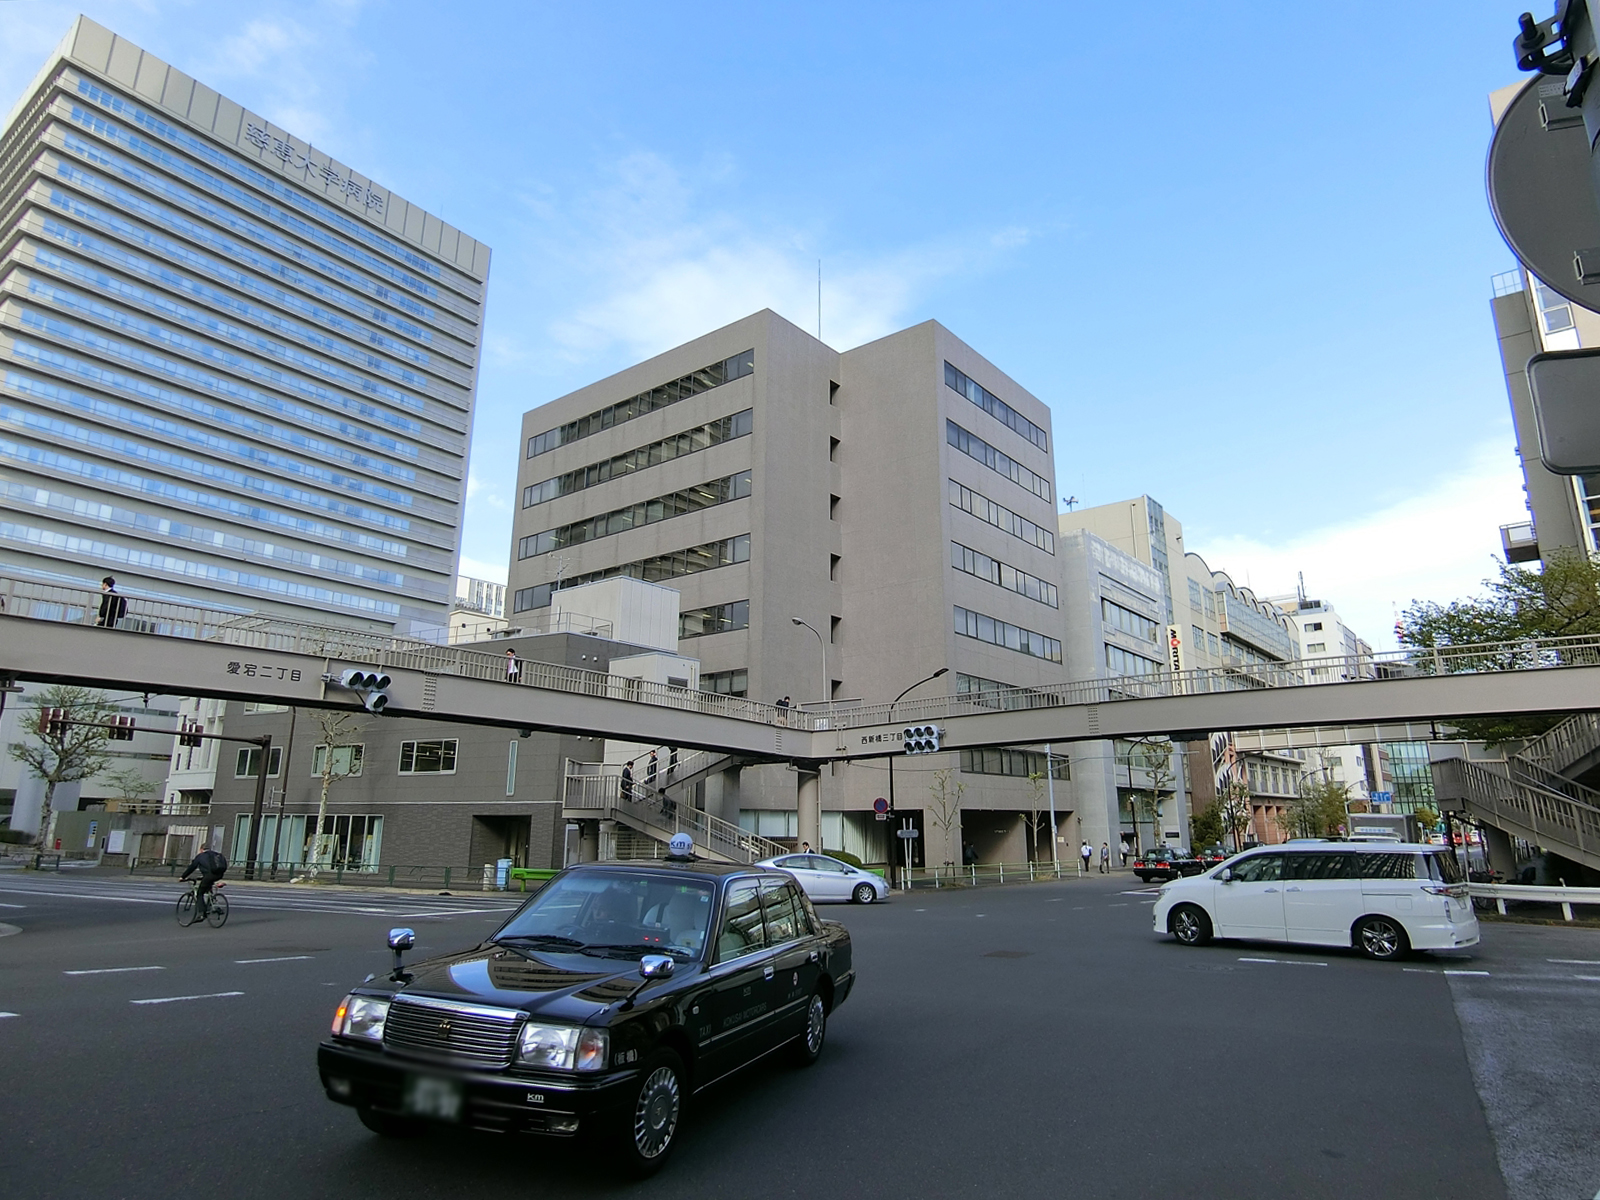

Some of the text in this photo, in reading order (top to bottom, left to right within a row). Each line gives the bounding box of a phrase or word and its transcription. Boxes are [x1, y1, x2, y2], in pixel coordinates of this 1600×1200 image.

[244, 122, 384, 215] 慈恵大学病院
[1170, 628, 1181, 671] MORITA
[227, 661, 302, 682] 愛宕二丁目
[861, 732, 903, 744] 西新橋三丁目
[699, 1024, 712, 1038] TAXI
[527, 1093, 544, 1103] km
